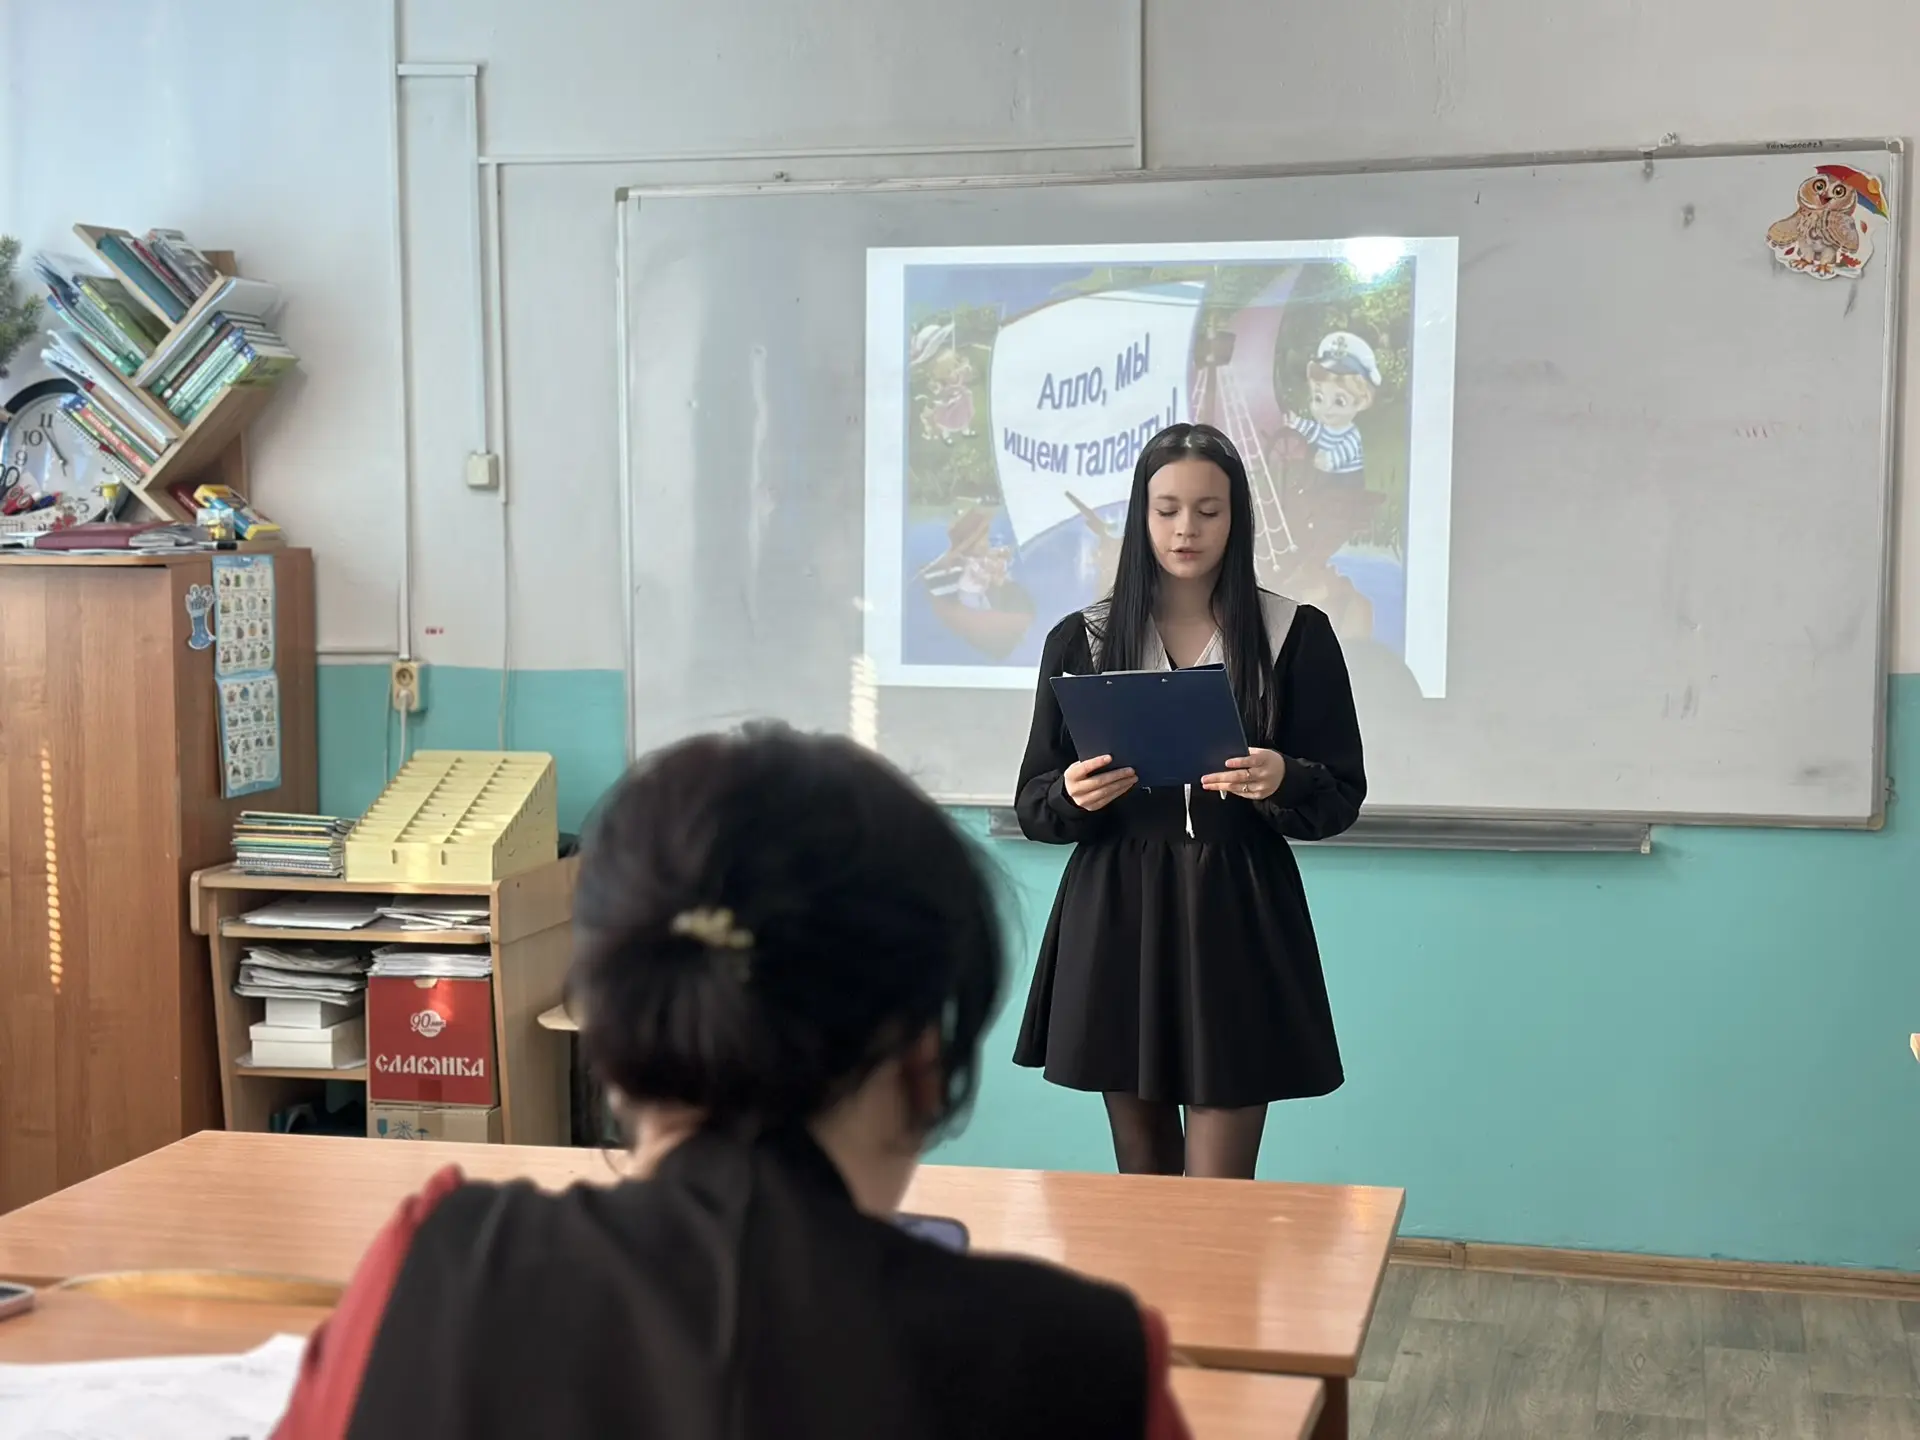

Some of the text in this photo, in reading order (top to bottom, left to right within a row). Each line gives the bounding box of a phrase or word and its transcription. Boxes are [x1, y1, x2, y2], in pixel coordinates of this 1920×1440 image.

[1037, 331, 1150, 410] Алло, мы
[22, 429, 43, 446] 10
[1004, 427, 1068, 472] ищем
[411, 1012, 431, 1030] 90
[375, 1054, 485, 1077] СЛАВЯНКА
